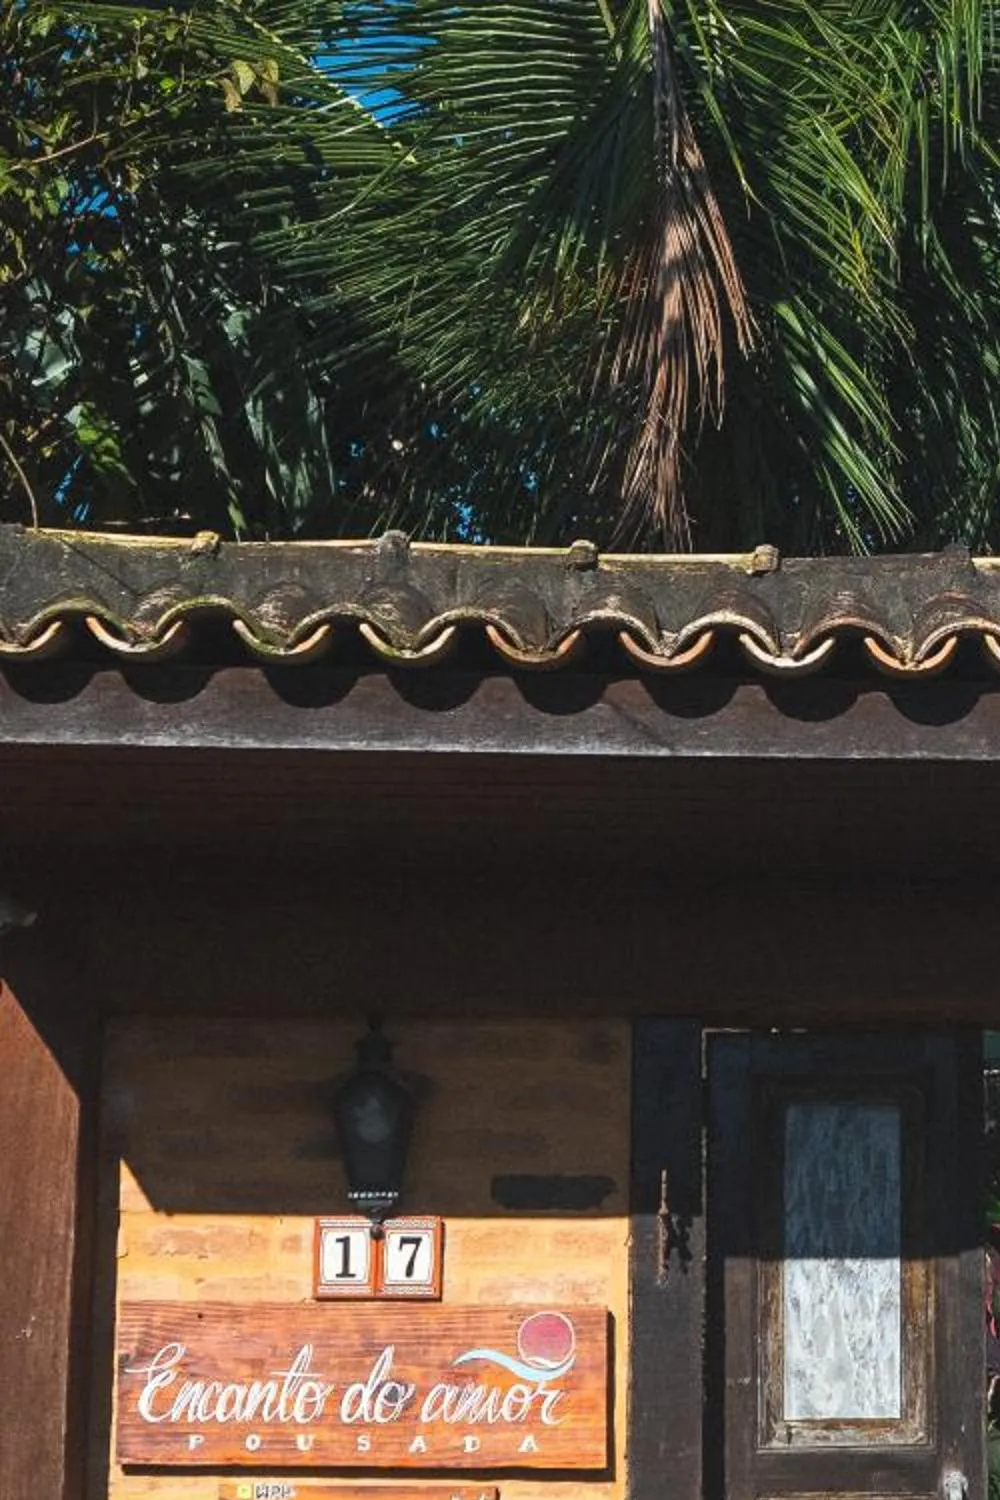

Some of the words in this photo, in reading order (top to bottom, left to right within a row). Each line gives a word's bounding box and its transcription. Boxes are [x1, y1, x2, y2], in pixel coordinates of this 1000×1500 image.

[125, 1342, 335, 1424] Encanto
[340, 1343, 415, 1425] do
[420, 1380, 566, 1426] amor
[187, 1433, 540, 1454] POUSADA
